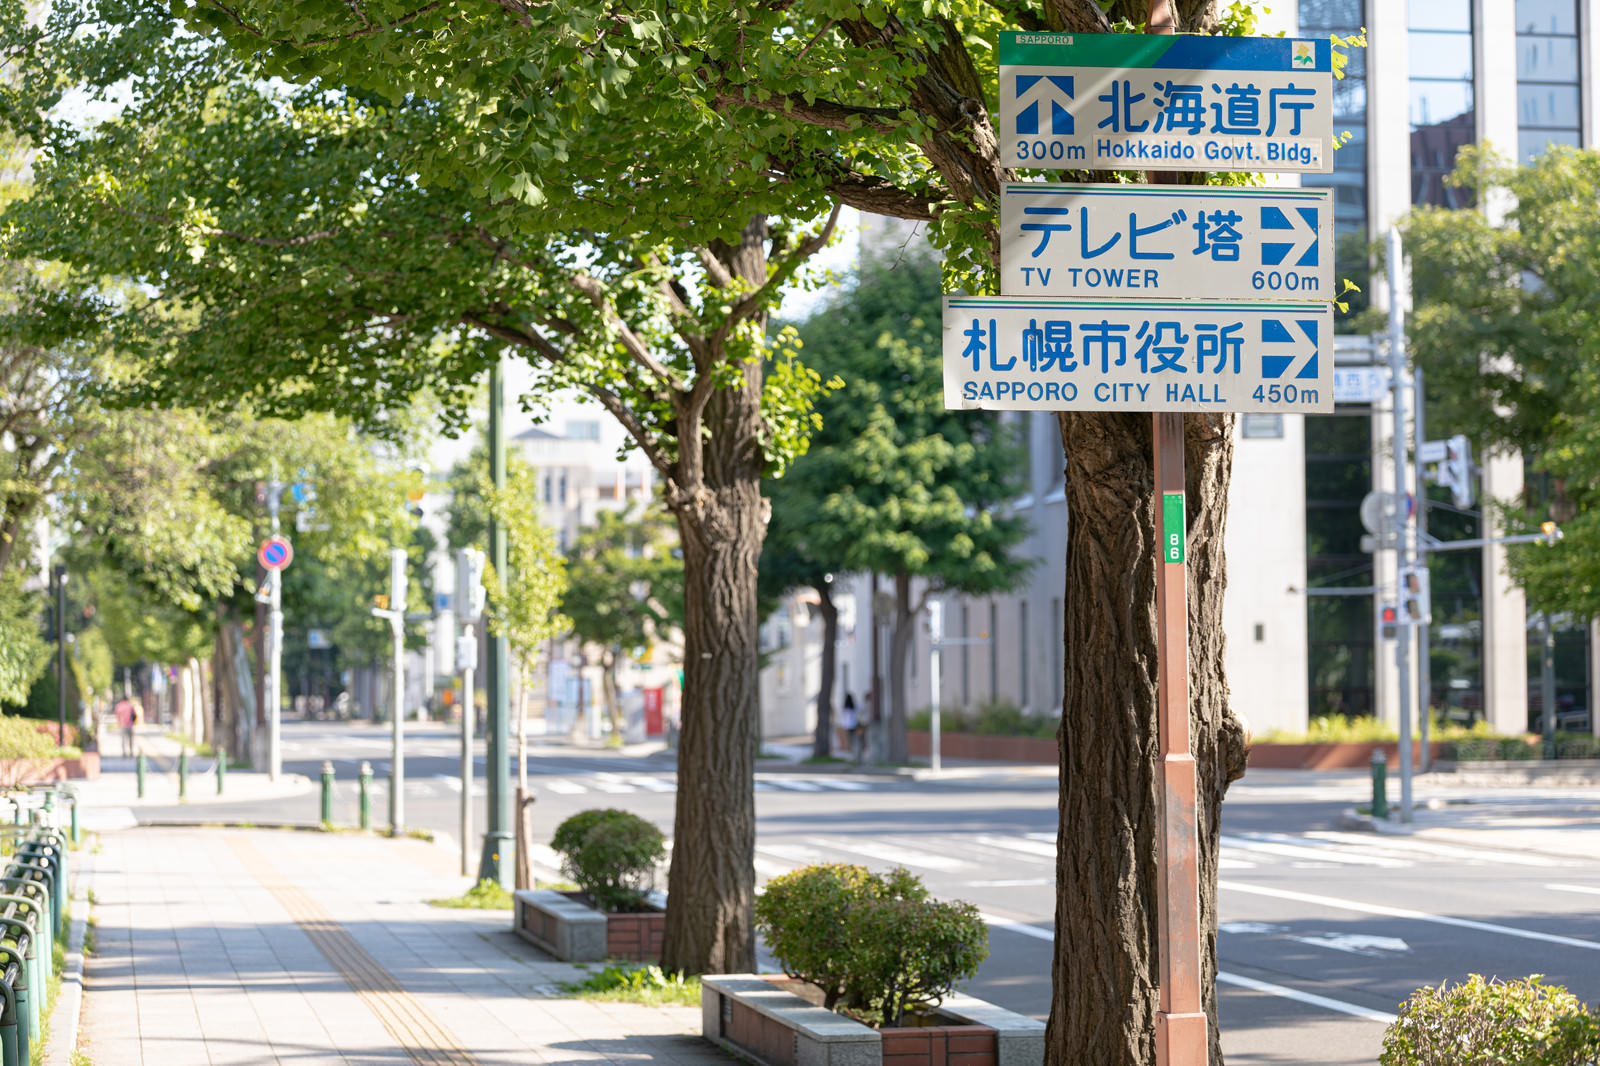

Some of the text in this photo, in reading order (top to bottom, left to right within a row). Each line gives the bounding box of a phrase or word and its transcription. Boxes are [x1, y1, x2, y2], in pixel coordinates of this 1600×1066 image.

[1020, 35, 1070, 44] SAPPORO
[1098, 80, 1316, 136] 北海道庁
[1017, 141, 1085, 160] 300m
[1098, 139, 1317, 164] Hokkaido Govt. Bldg.
[1021, 206, 1243, 261] テレビ塔
[1021, 268, 1158, 288] TV TOWER
[1252, 272, 1318, 290] 600m
[962, 318, 1244, 374] 札幌市役所
[964, 381, 1226, 402] SAPPORO CITY HALL
[1252, 384, 1318, 403] 450m
